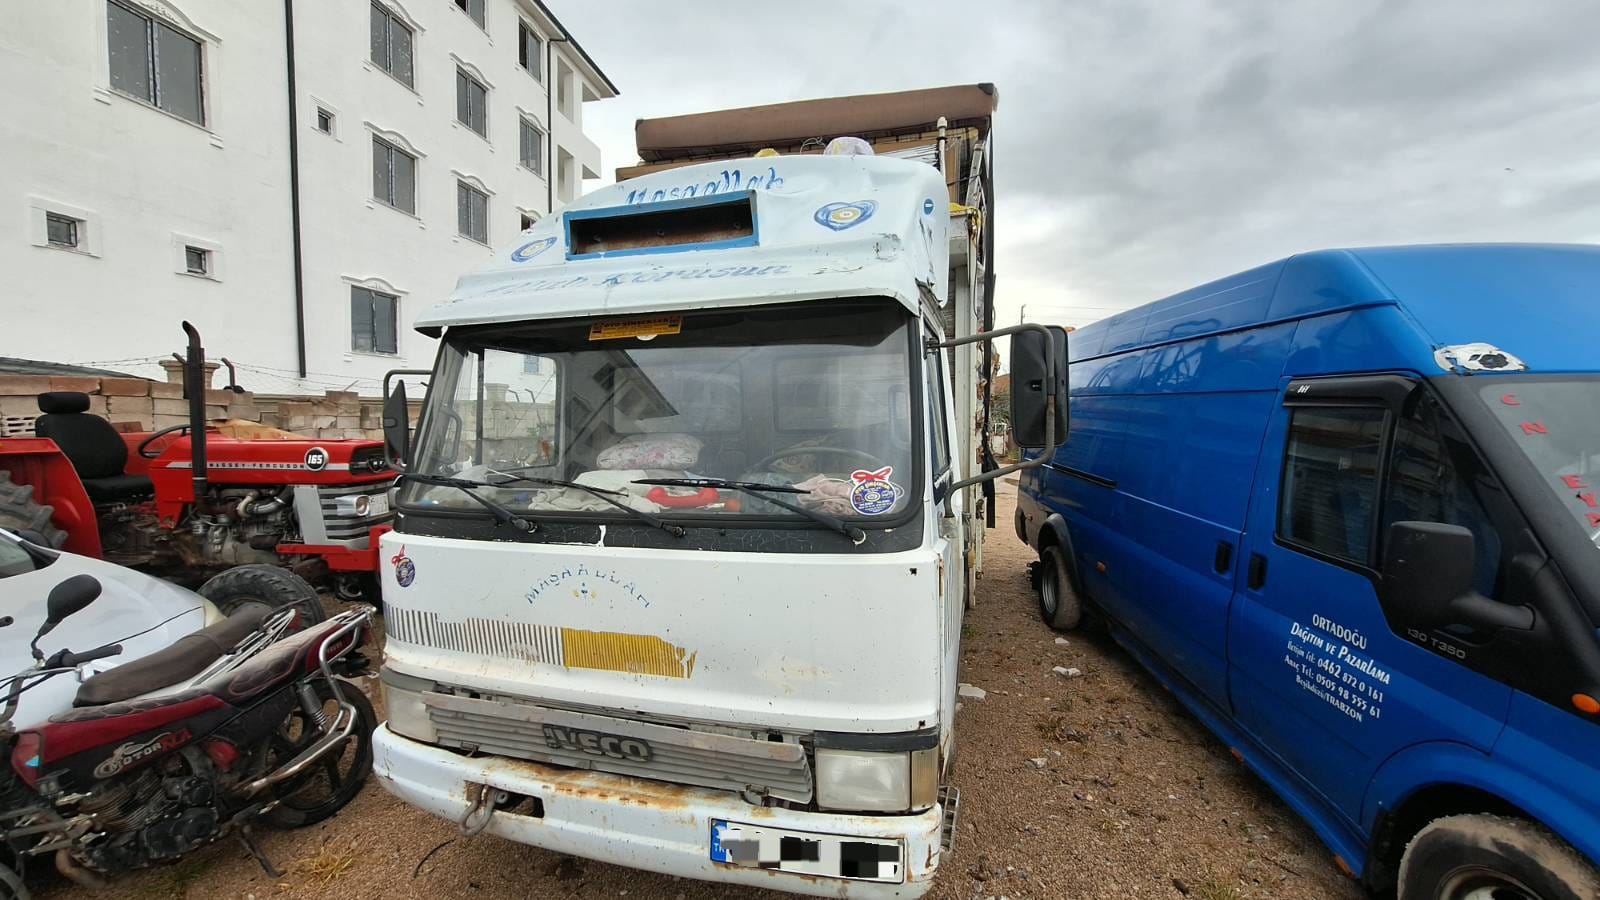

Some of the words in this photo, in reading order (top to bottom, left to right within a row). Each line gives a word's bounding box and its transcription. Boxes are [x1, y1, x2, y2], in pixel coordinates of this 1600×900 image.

[308, 455, 323, 465] 165
[1312, 614, 1368, 650] ORTADOĞU
[1407, 627, 1428, 642] 130
[1430, 637, 1466, 659] T350
[1315, 673, 1337, 691] 0505
[1338, 686, 1349, 700] 98
[1352, 694, 1368, 711] 555
[1369, 705, 1381, 718] 61
[1317, 658, 1341, 678] 0462
[1342, 672, 1357, 688] 872
[1358, 681, 1366, 692] 0
[1368, 686, 1383, 702] 161
[542, 724, 649, 763] IVECO
